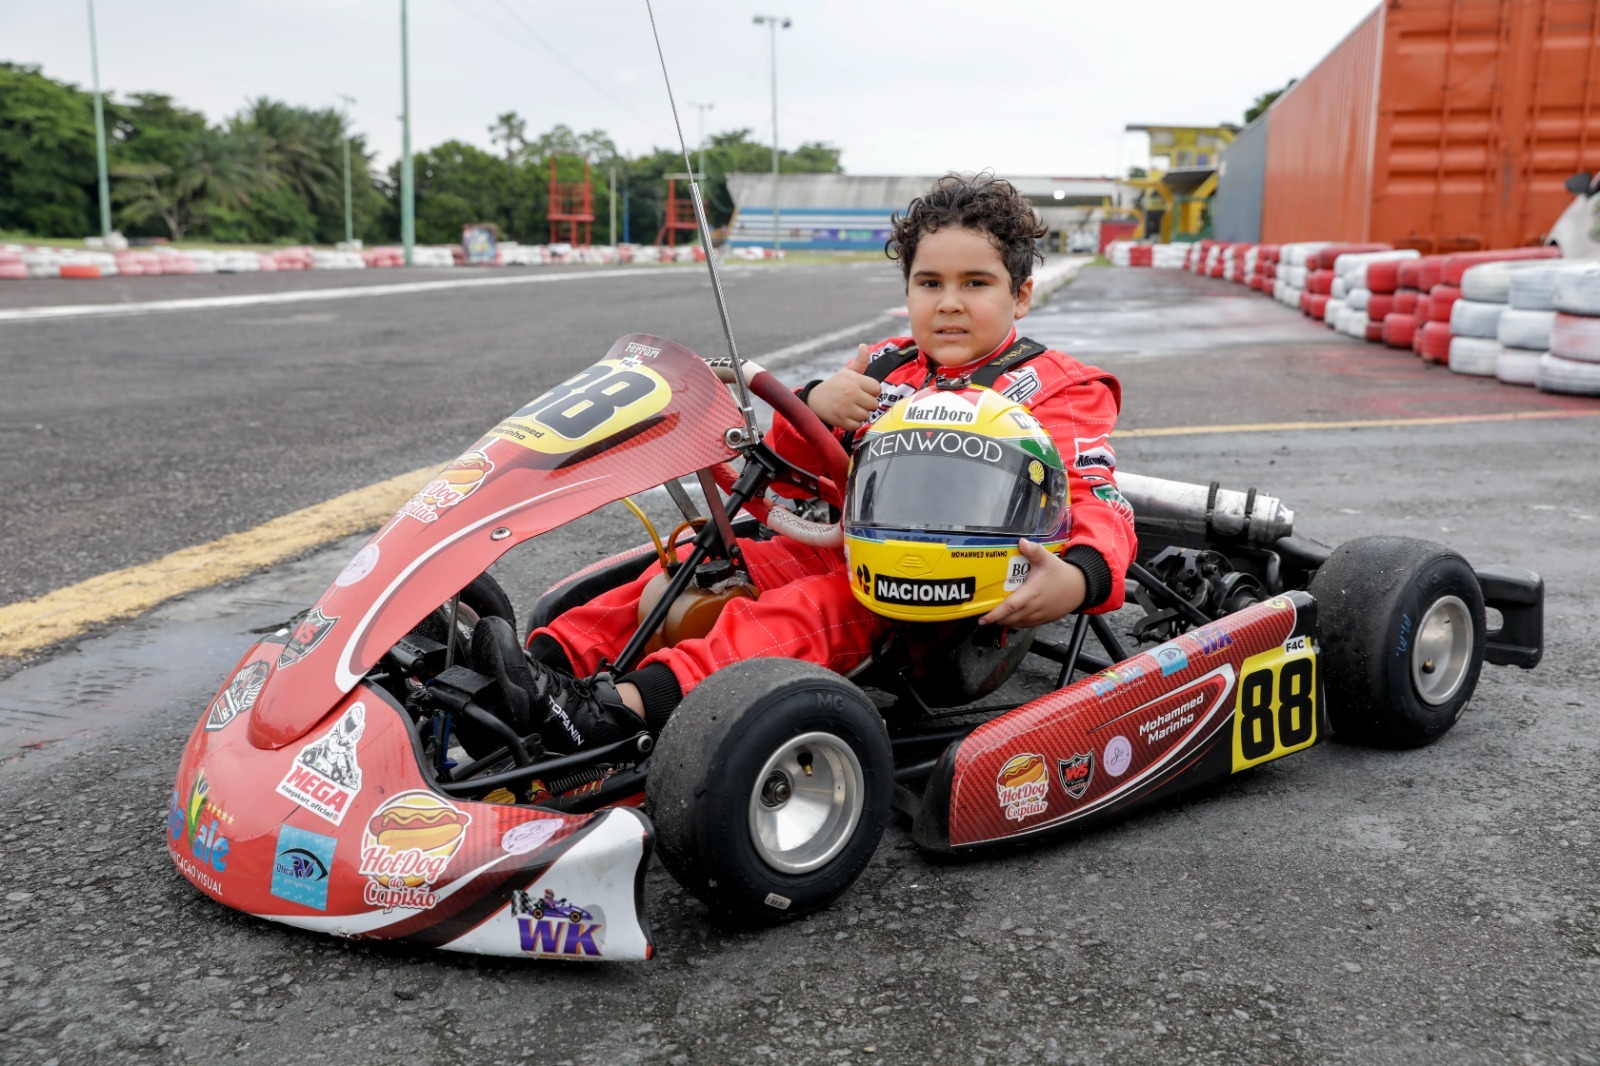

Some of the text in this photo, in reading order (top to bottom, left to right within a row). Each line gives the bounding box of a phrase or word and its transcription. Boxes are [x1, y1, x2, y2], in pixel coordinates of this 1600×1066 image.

[619, 358, 639, 369] F4C
[625, 342, 661, 359] Ferrari
[509, 364, 657, 441] 88
[905, 405, 974, 423] Marlboro
[867, 430, 1004, 463] KENWOOD
[951, 550, 984, 559] MOHAMMED
[1012, 562, 1031, 577] BO
[877, 578, 971, 602] NACIONAL
[1285, 638, 1305, 653] F4C
[816, 692, 846, 712] MG
[1139, 691, 1205, 737] Mohammed
[1240, 657, 1314, 761] 88
[548, 694, 585, 747] TOFANIN
[1148, 711, 1195, 745] Marinho
[286, 764, 349, 813] MEGA
[291, 854, 316, 880] RV
[196, 868, 223, 896] VISUAL
[388, 876, 403, 889] do
[364, 882, 438, 913] Capitão
[517, 917, 604, 957] WK
